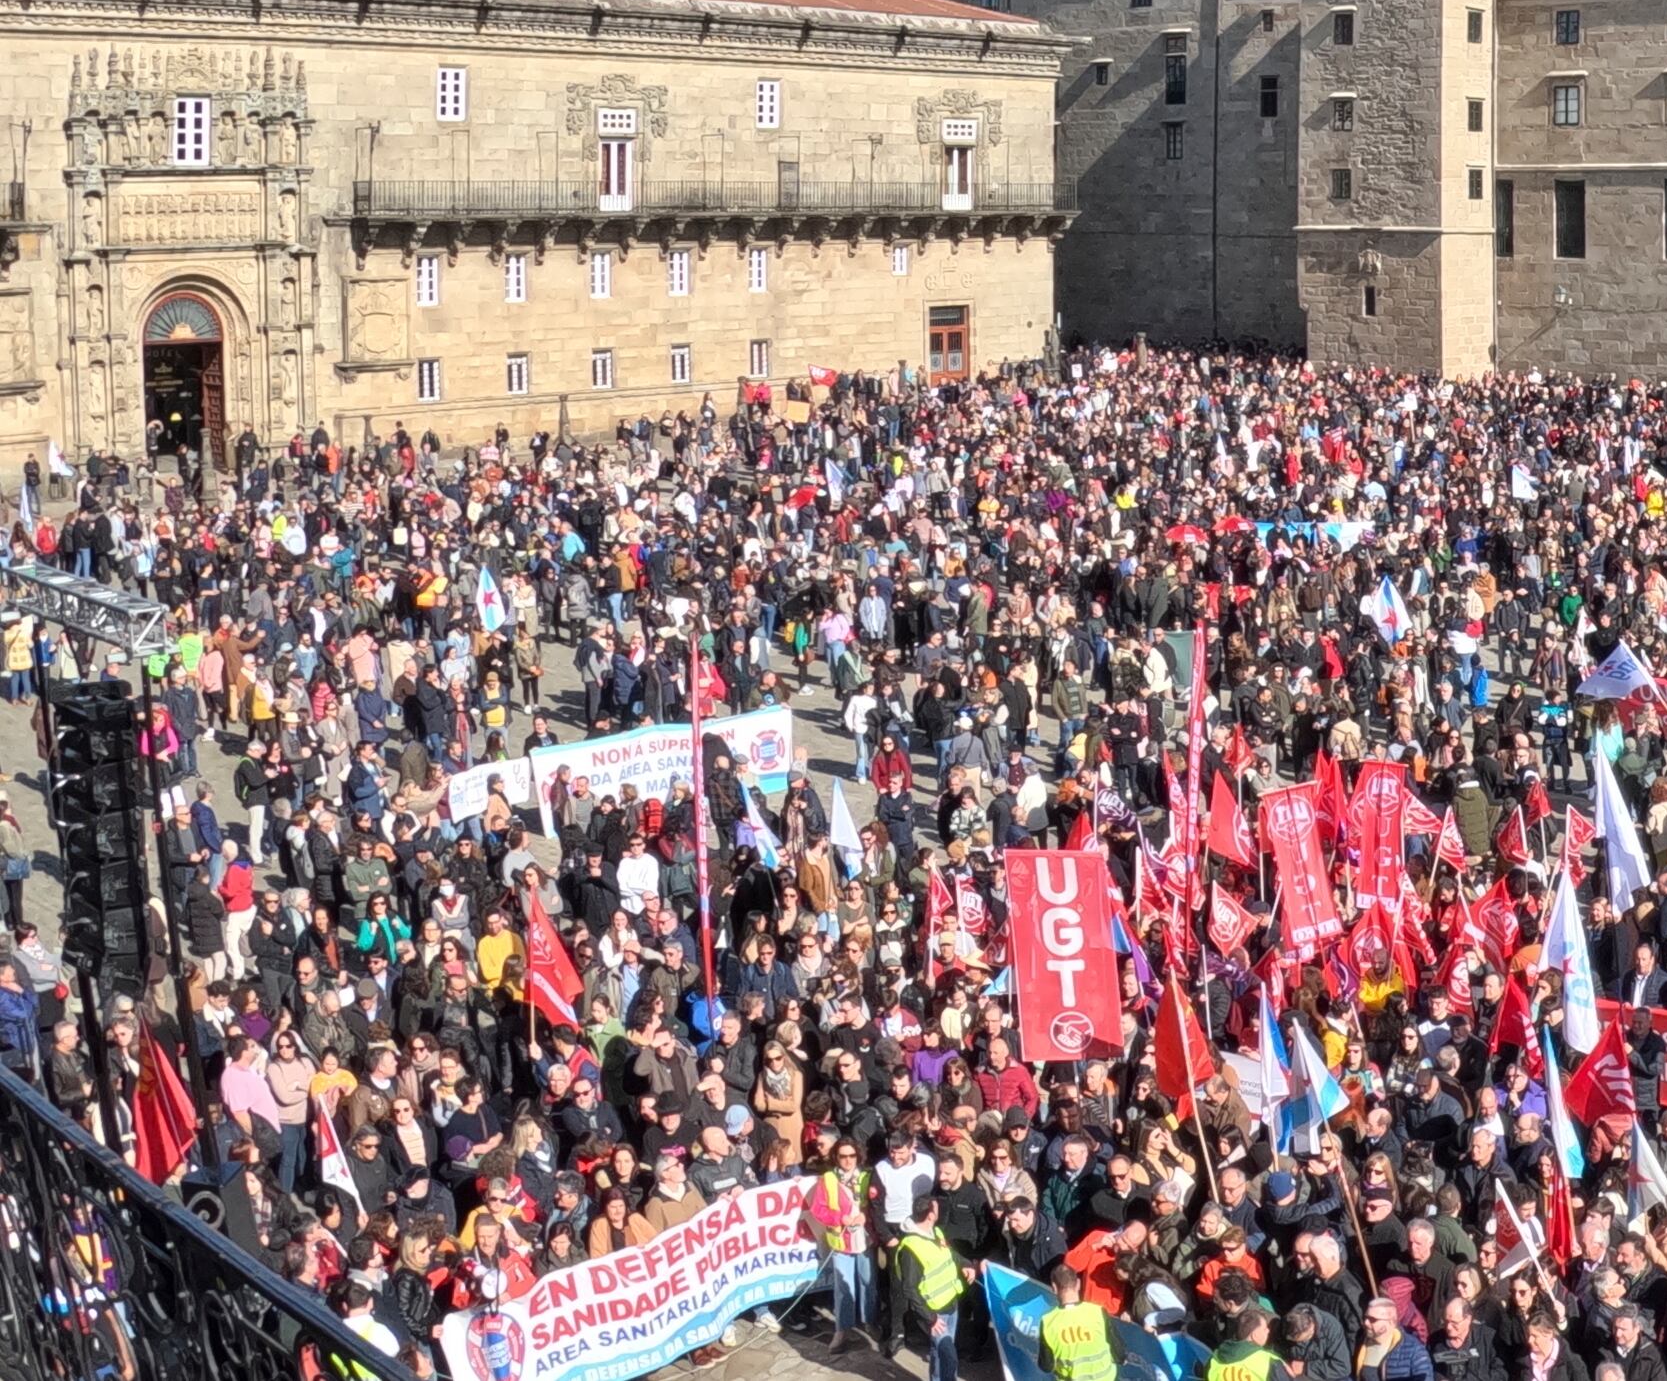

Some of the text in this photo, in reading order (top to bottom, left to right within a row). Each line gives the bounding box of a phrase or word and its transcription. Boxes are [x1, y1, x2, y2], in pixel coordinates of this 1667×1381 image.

[1034, 857, 1085, 1008] UGT
[528, 1184, 812, 1318] EN DEFENSA DA
[531, 1272, 692, 1351] SANIDADE
[695, 1221, 816, 1285] PÚBLICA
[598, 1291, 712, 1347] SANITARIA
[712, 1272, 729, 1298] DA
[734, 1249, 821, 1280] MARIÑA
